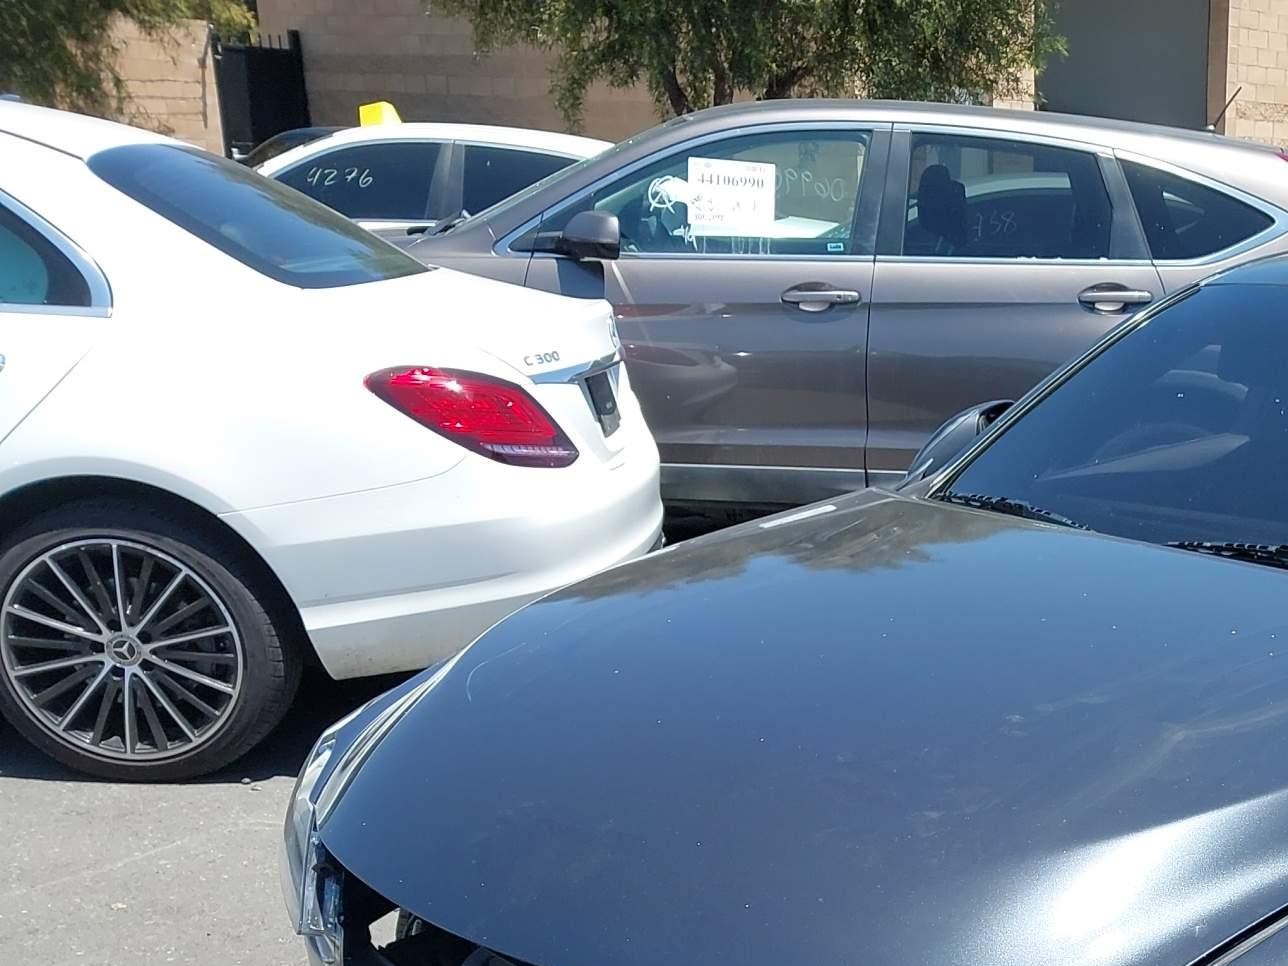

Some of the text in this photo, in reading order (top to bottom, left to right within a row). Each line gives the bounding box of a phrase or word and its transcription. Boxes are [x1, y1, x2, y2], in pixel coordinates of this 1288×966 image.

[306, 167, 373, 188] 4276
[697, 173, 765, 190] 44106990
[523, 350, 561, 367] C 300
